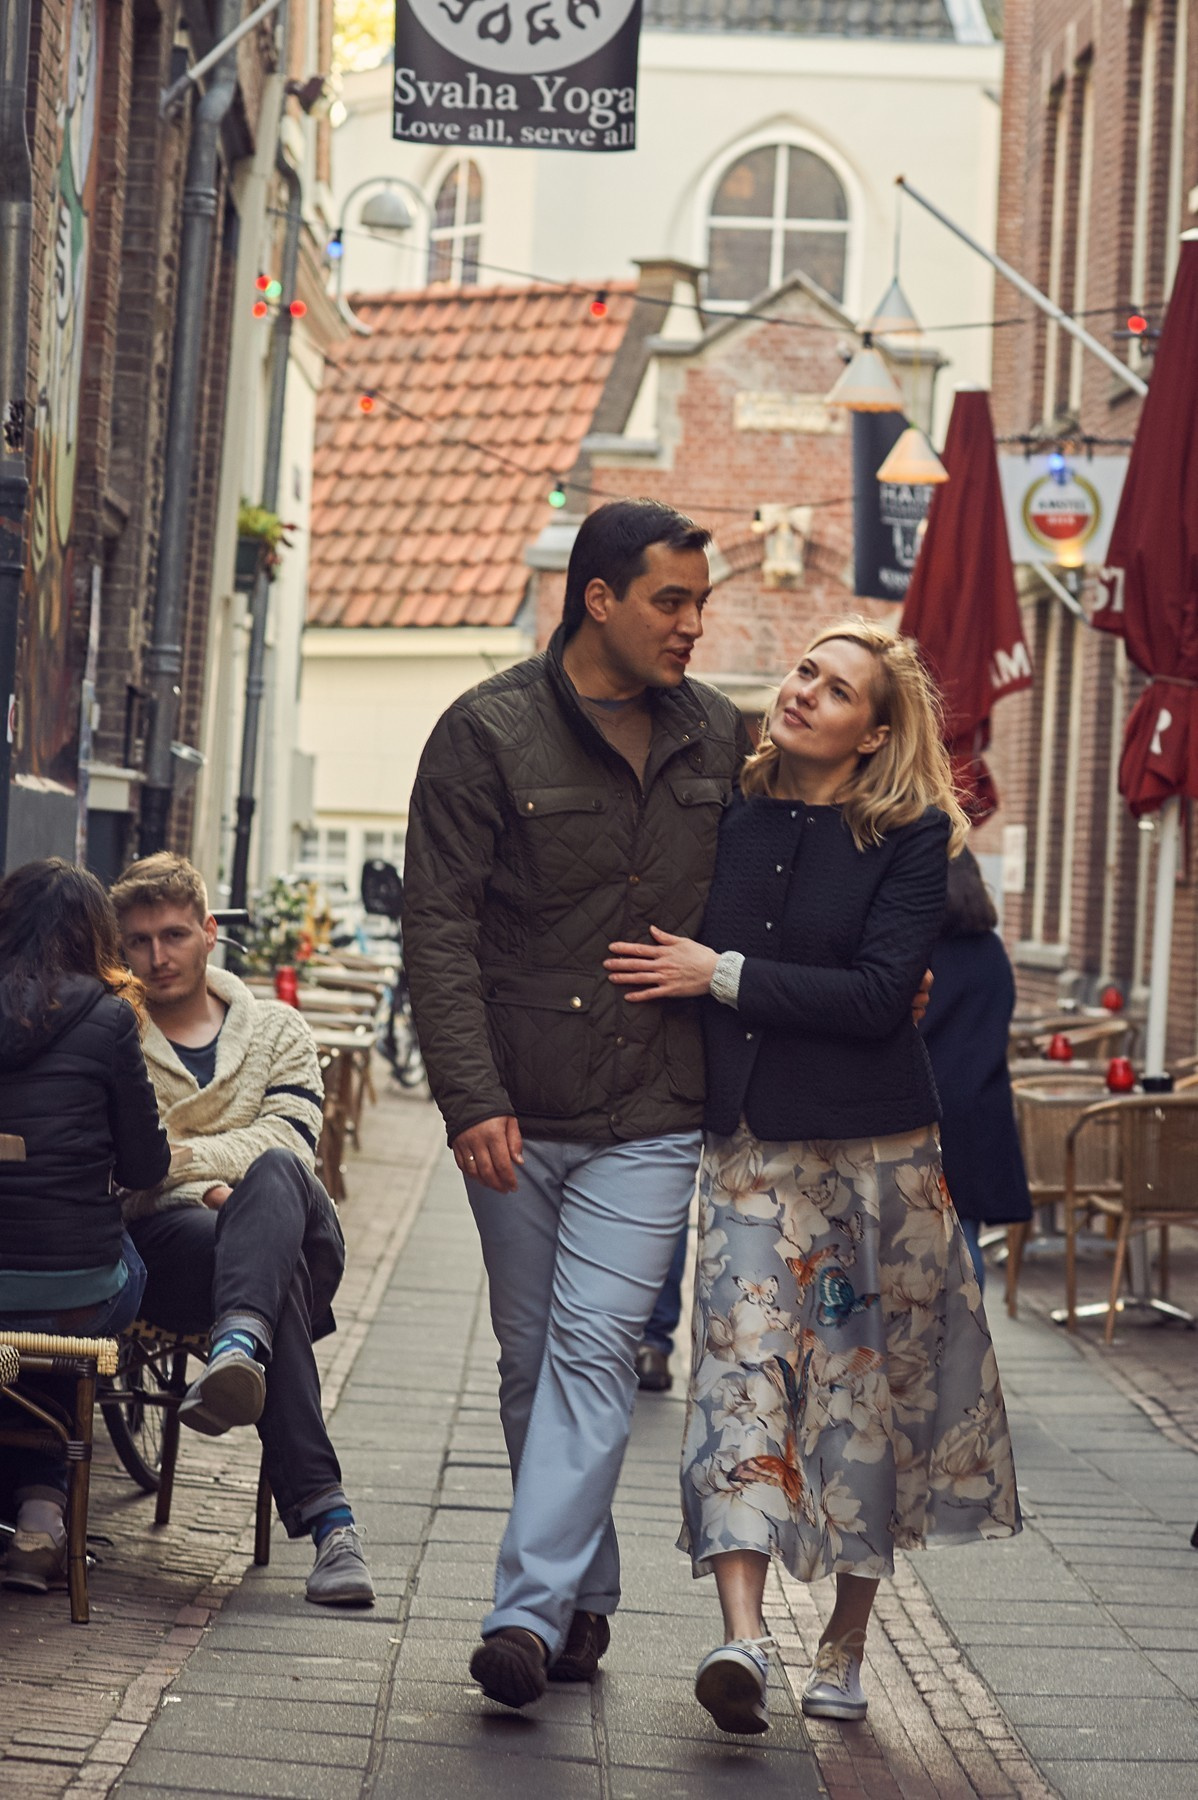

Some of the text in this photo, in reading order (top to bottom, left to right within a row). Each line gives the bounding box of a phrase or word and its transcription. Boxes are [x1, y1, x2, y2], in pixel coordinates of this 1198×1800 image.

[395, 67, 634, 129] Svaha Yoga
[395, 112, 634, 146] Love all, serve all
